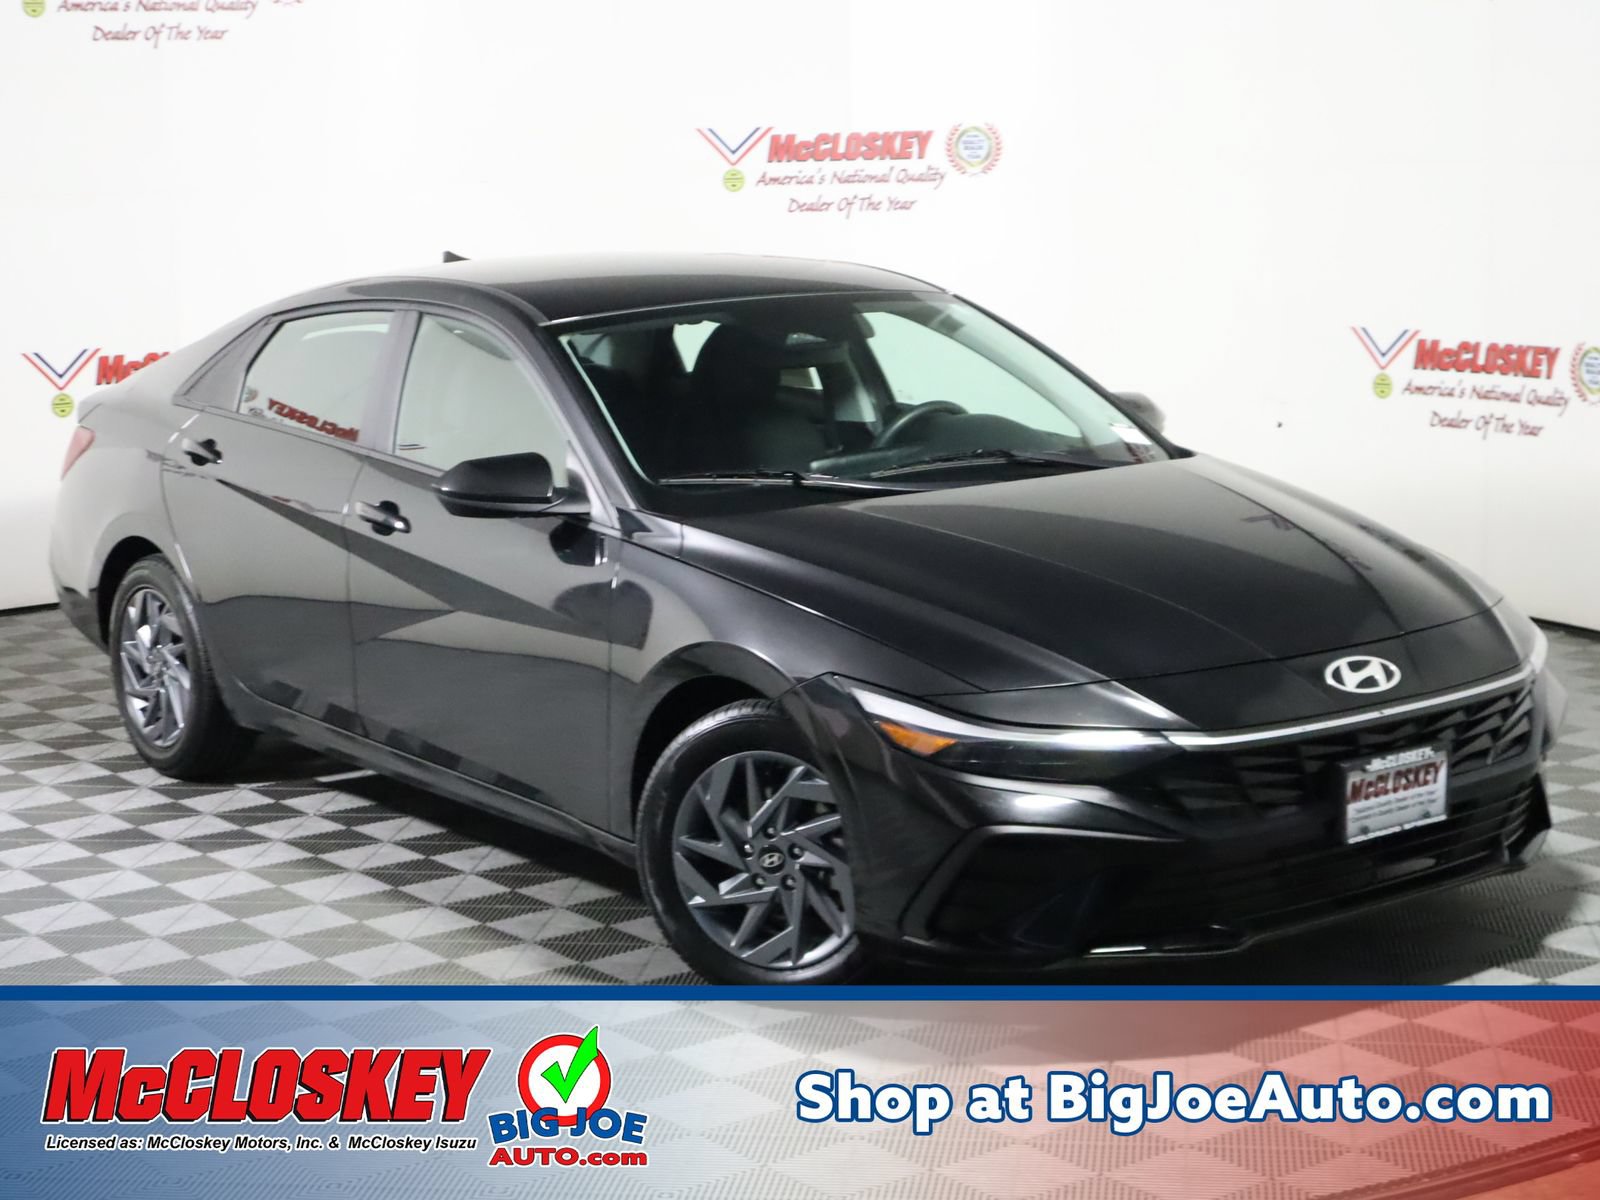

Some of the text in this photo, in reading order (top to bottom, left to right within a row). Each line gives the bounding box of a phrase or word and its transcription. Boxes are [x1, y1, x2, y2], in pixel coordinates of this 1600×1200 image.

[92, 23, 228, 48] Dealer Of The Year
[767, 130, 933, 163] McCLOSKEY
[756, 167, 826, 187] America's
[831, 166, 893, 185] National
[895, 165, 946, 190] Quality
[787, 194, 918, 219] Dealer Of The Year
[1413, 338, 1560, 380] McCLOSKEY
[1402, 379, 1466, 399] America's
[1471, 384, 1525, 404] National
[1526, 386, 1570, 417] Quality
[1430, 410, 1543, 440] Dealer Of The Year
[1350, 760, 1443, 801] McCLOSKEY
